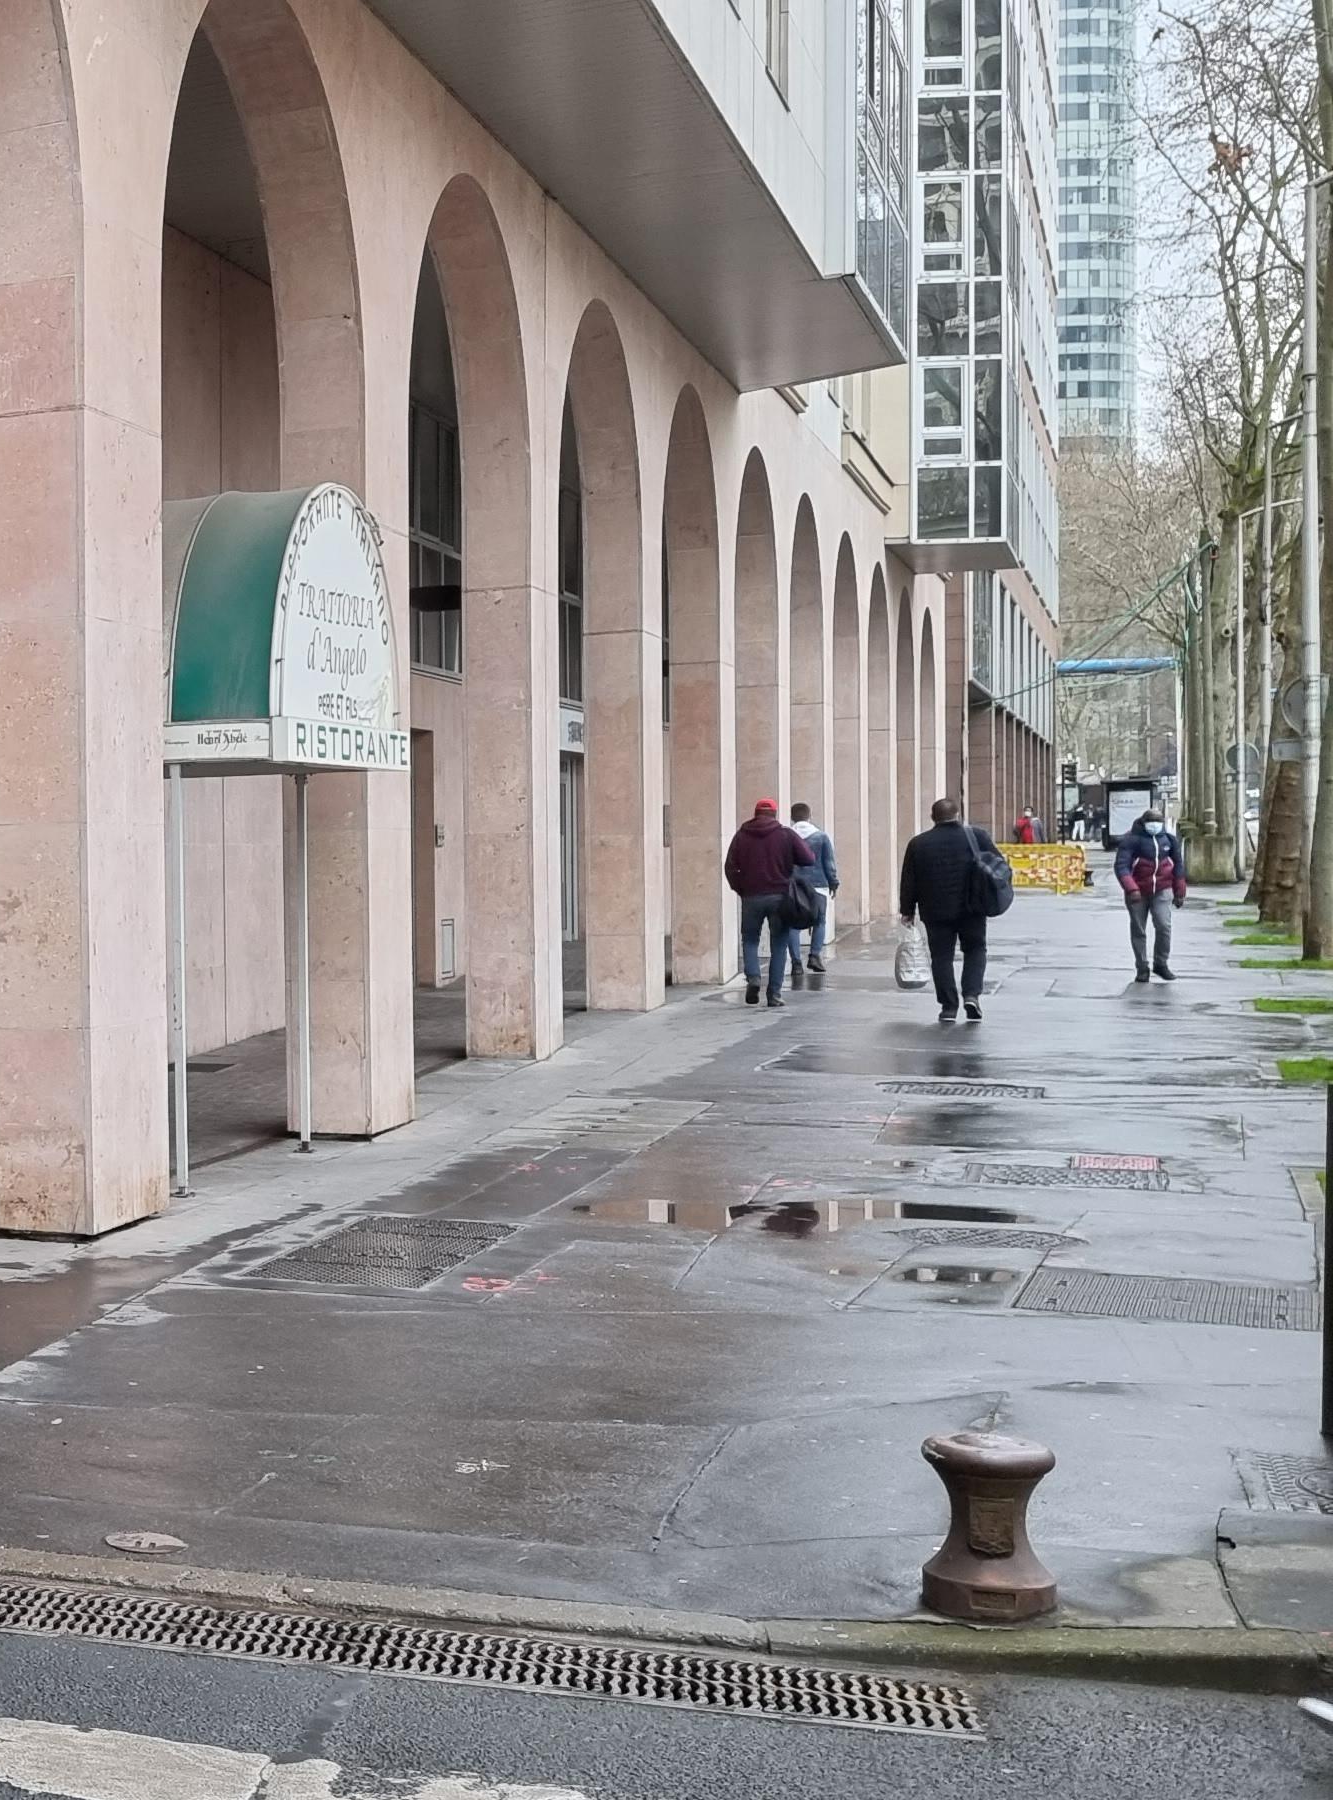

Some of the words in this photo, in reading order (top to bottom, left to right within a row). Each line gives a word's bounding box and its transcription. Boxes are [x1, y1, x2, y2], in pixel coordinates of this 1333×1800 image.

[297, 579, 374, 630] TRATTORIA
[307, 626, 367, 691] d'Angelo
[336, 693, 344, 721] ET
[345, 696, 358, 721] FILS
[296, 722, 408, 766] RISTORANTE
